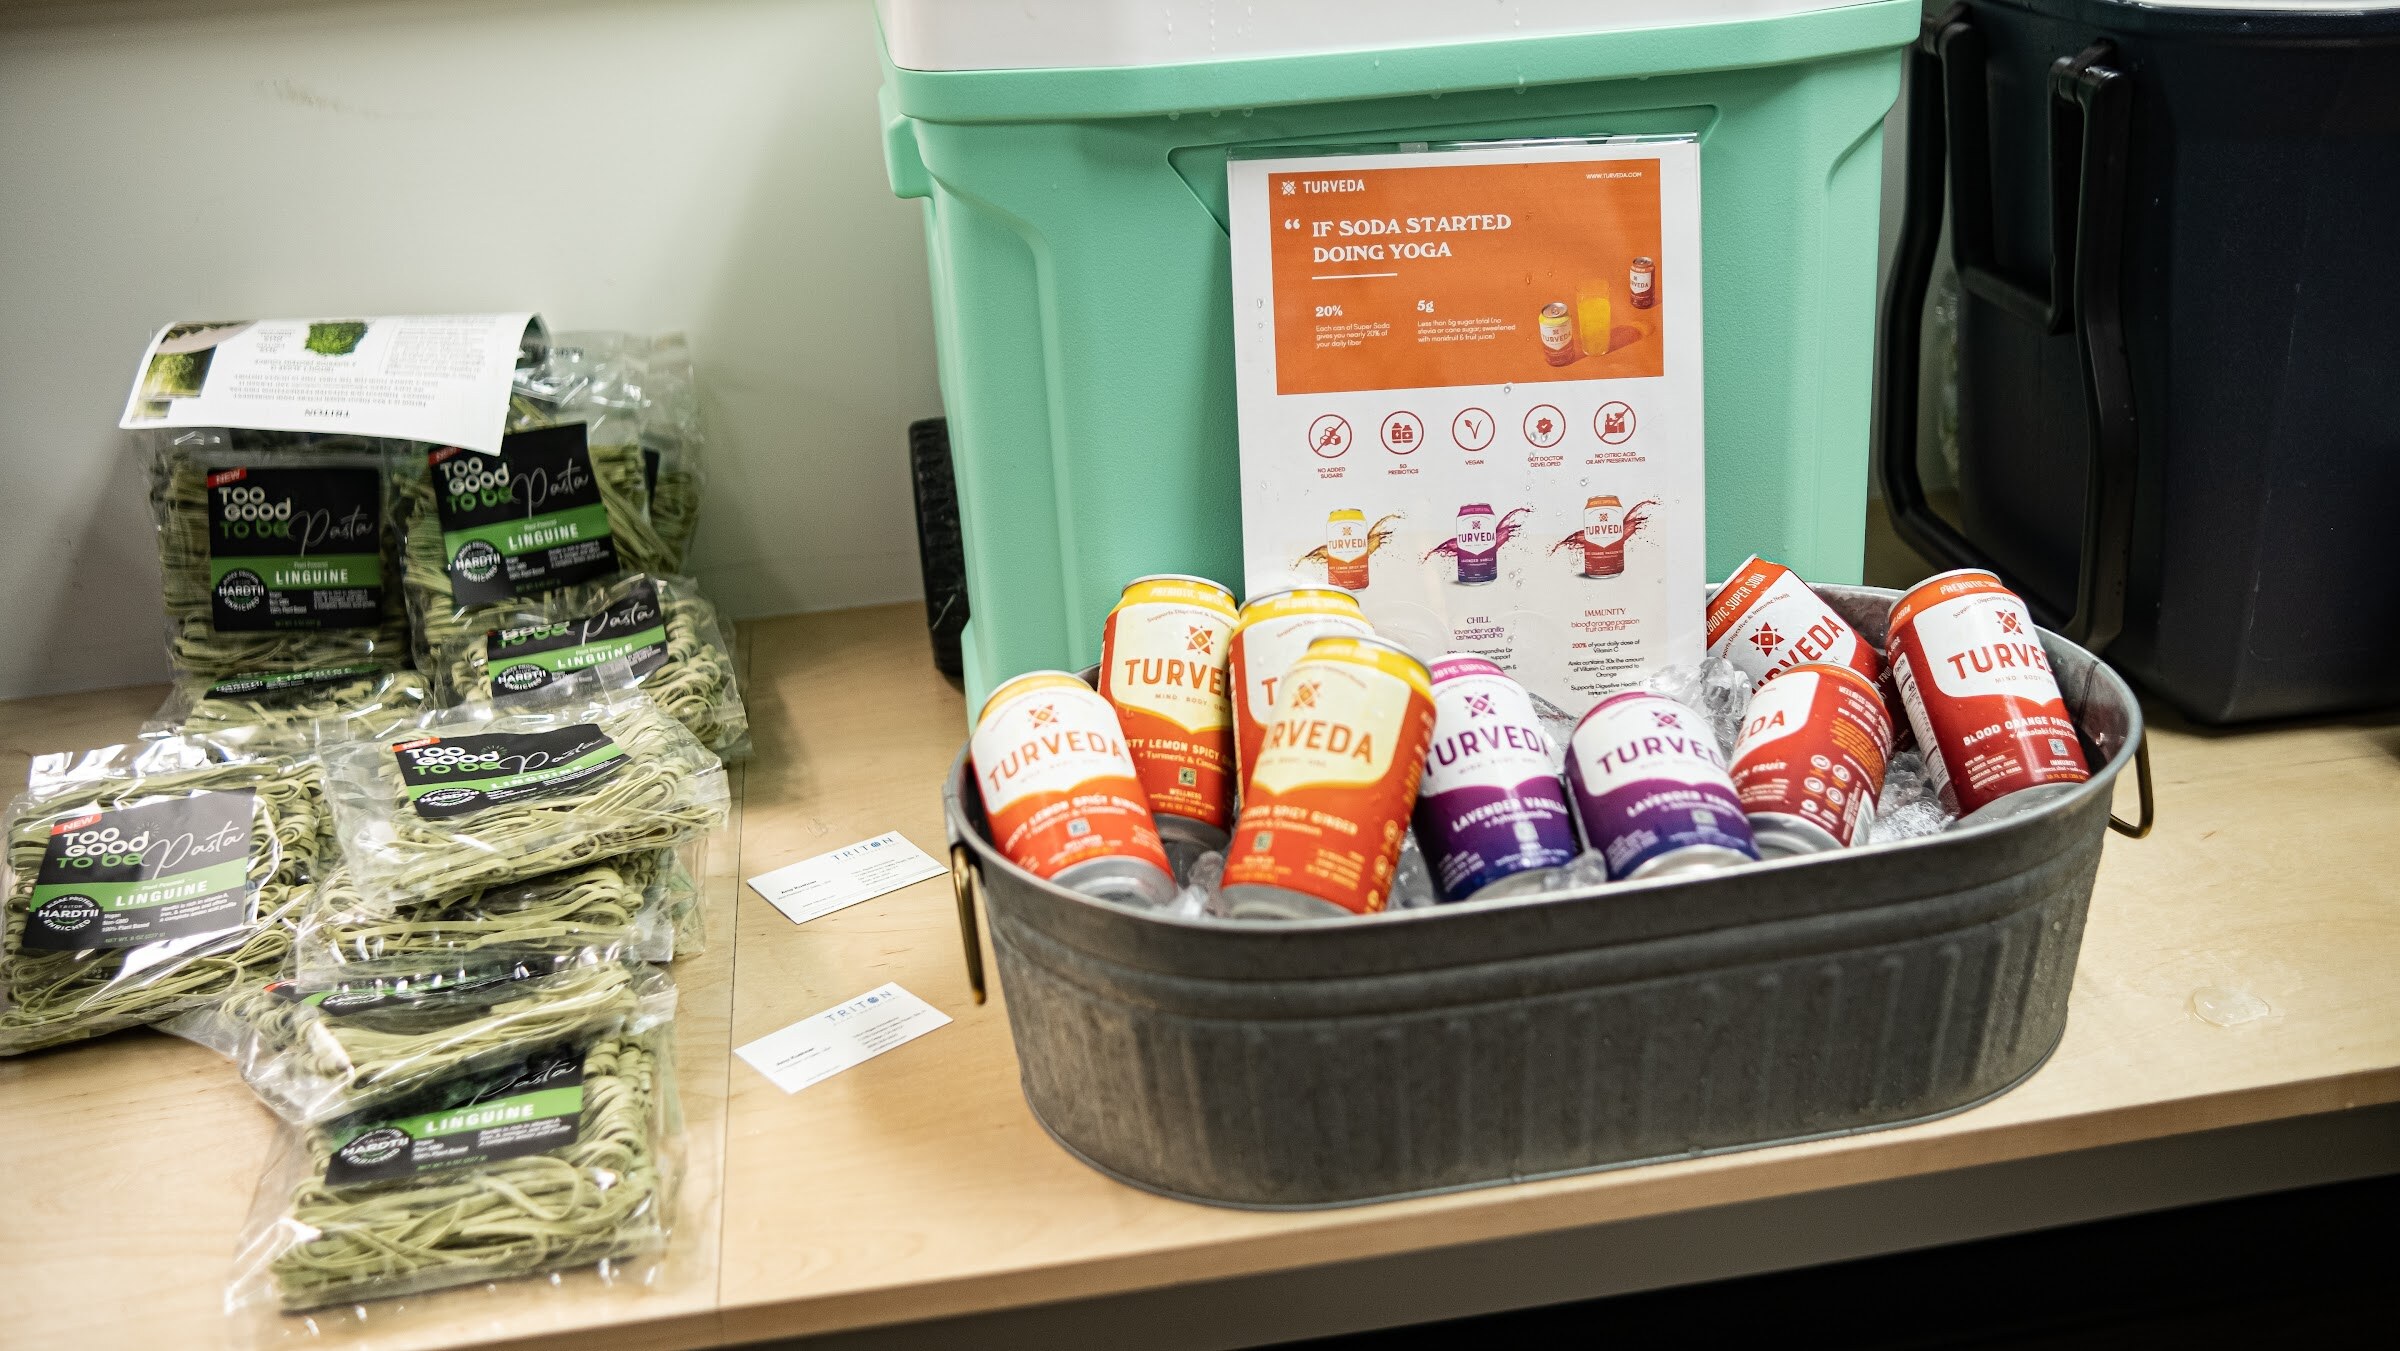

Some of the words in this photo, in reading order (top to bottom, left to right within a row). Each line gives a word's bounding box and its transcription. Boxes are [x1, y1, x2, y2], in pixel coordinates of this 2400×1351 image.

[1586, 172, 1642, 180] WWW.TURVEDA.COM
[1303, 179, 1365, 194] TURVEDA
[1312, 221, 1334, 237] IF
[1339, 218, 1401, 236] SODA
[1406, 214, 1512, 234] STARTED
[1313, 244, 1384, 263] DOING
[1389, 241, 1452, 259] YOGA
[1315, 305, 1343, 318] 20%
[1417, 300, 1435, 313] 5g
[1316, 333, 1333, 341] gives
[1347, 331, 1366, 339] nearly
[1353, 323, 1372, 331] Super
[215, 469, 241, 484] NEW
[440, 456, 484, 480] TOO
[218, 486, 266, 505] TOO
[510, 457, 589, 519] Pasta
[448, 492, 477, 514] TO
[219, 521, 250, 539] TO
[287, 504, 373, 558] Pasta
[508, 523, 579, 551] LINGUINE
[1458, 532, 1495, 543] TURVEDA
[1585, 524, 1623, 535] TURVEDA
[1328, 538, 1367, 549] TURVEDA
[275, 569, 349, 586] LINGUINE
[1725, 586, 1752, 611] SUPER
[1745, 572, 1767, 589] SODA
[1940, 580, 1987, 595] PREBIOTIC
[1466, 616, 1491, 624] CHILL
[1584, 608, 1627, 617] IMMUNITY
[1728, 619, 1748, 642] Digestive
[1752, 600, 1774, 615] Immune
[1773, 593, 1791, 602] Health
[1456, 632, 1503, 640] ashwagandha
[557, 642, 633, 669] LINGUINE
[1752, 615, 1845, 695] RVEDA
[1947, 643, 2054, 680] TURVE
[1125, 658, 1229, 696] TURVE
[1155, 692, 1178, 700] MIND
[1186, 696, 1208, 706] BODY
[1963, 724, 2001, 746] BLOOD
[2004, 716, 2049, 730] ORANGE
[1149, 739, 1188, 752] LEMON
[1192, 744, 1220, 760] SPICY
[1265, 719, 1372, 764] RVEDA
[406, 747, 466, 758] TOO
[989, 730, 1127, 791] TURVEDA
[1146, 751, 1186, 762] Turmeric
[1597, 735, 1728, 775] TURVED
[413, 764, 451, 776] TO
[489, 765, 584, 790] LINGUINE
[62, 815, 95, 832] NEW
[1452, 798, 1521, 832] LAVENDER
[63, 827, 120, 845] TOO
[140, 820, 245, 880] Pasta
[56, 857, 94, 868] TO
[116, 880, 208, 907] LINGUINE
[38, 909, 99, 918] HARDTII
[43, 919, 91, 932] ENRICHED
[424, 1103, 535, 1134] LINGUINE
